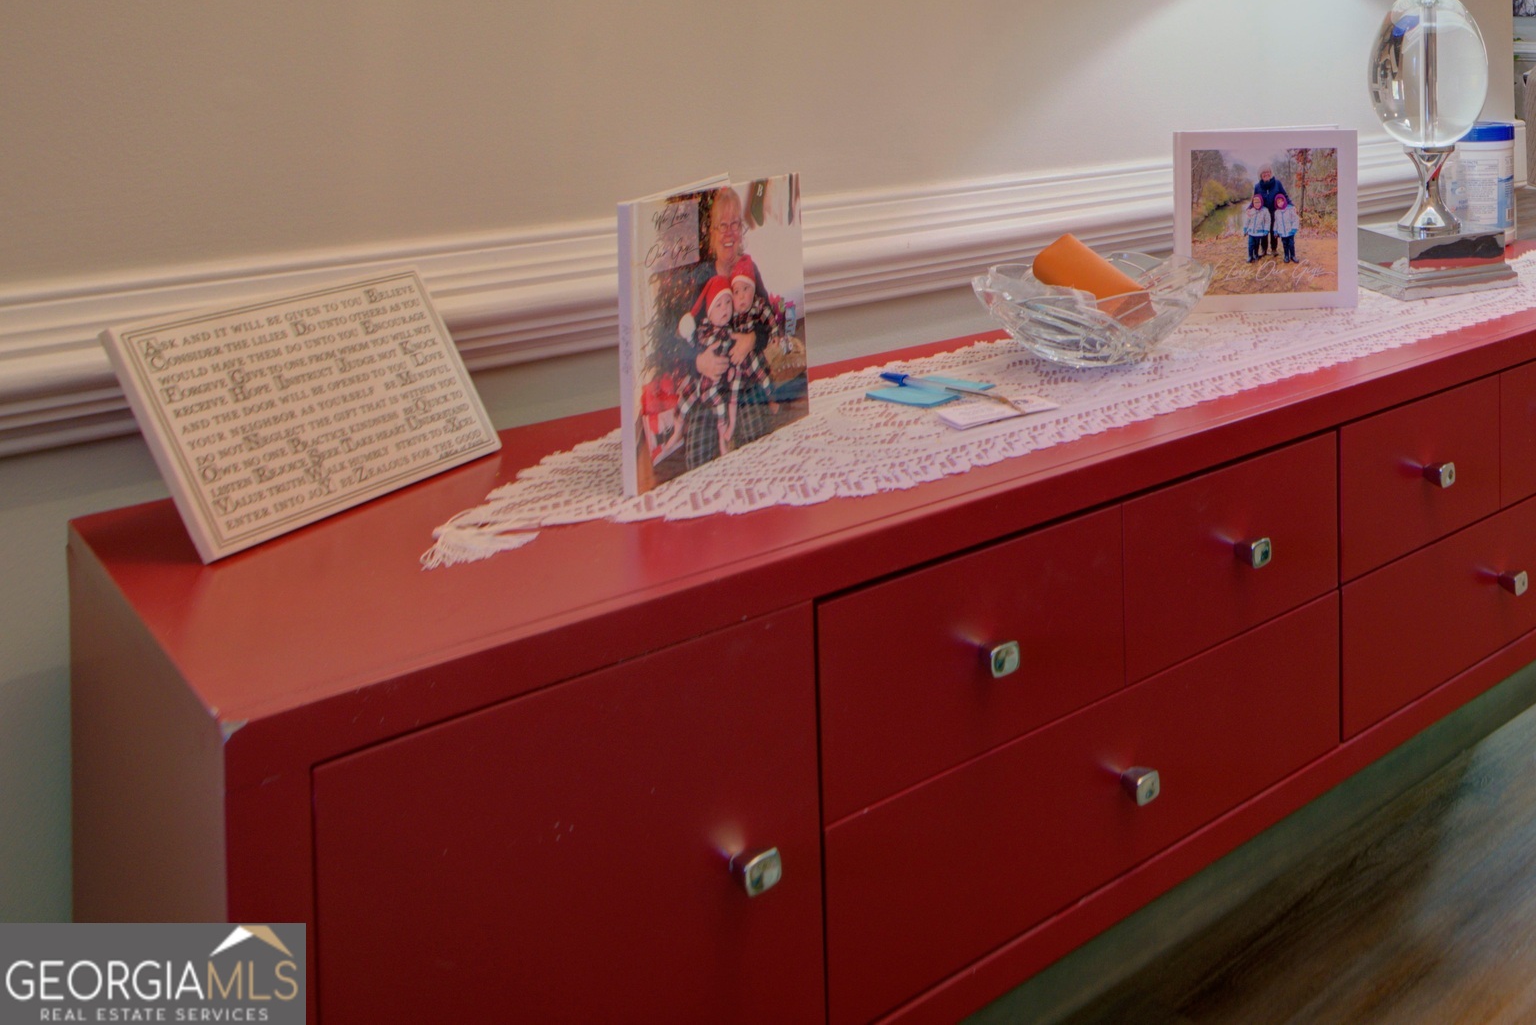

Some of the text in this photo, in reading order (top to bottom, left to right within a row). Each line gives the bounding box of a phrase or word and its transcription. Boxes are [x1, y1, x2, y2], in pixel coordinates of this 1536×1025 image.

[181, 332, 211, 345] AND
[214, 329, 227, 337] IT
[231, 320, 264, 333] WILL
[266, 316, 282, 325] BE
[285, 307, 321, 320] GIVEN
[323, 303, 338, 312] TO
[341, 298, 362, 307] YOU
[224, 340, 250, 352] THE
[251, 331, 288, 345] LILIES
[318, 317, 347, 329] UNTO
[348, 307, 387, 321] OTHERS
[402, 299, 420, 308] YOU
[267, 365, 283, 374] TO
[284, 359, 306, 370] ONE
[307, 351, 337, 363] FROM
[338, 342, 369, 355] WHOM
[371, 337, 390, 346] YOU
[391, 331, 413, 341] WILL
[414, 326, 431, 335] NOT
[157, 367, 208, 386] WOULD
[211, 358, 246, 372] HAVE
[247, 348, 282, 363] THEM
[285, 343, 303, 353] DO
[304, 335, 336, 348] UNTO
[337, 329, 359, 339] YOU
[173, 396, 228, 417] RECEIVE
[377, 350, 398, 360] NOT
[180, 419, 210, 433] AND
[212, 410, 240, 424] THE
[242, 400, 276, 415] DOOR
[279, 391, 309, 404] WILL
[311, 386, 325, 395] BE
[327, 373, 370, 390] OPENED
[372, 369, 385, 377] TO
[387, 362, 407, 373] YOU
[187, 432, 226, 450] YOUR
[229, 411, 296, 437] NEIGHBOR
[300, 405, 315, 415] AS
[317, 387, 375, 410] YOURSELF
[384, 381, 397, 389] BE
[195, 453, 215, 465] DO
[217, 444, 244, 458] NOT
[308, 417, 331, 429] THE
[333, 409, 358, 421] GIFT
[360, 400, 387, 413] THAT
[389, 396, 399, 404] IS
[400, 384, 437, 400] WITHIN
[438, 378, 456, 388] YOU
[242, 457, 260, 468] NO
[262, 448, 288, 461] ONE
[403, 407, 414, 415] BE
[451, 391, 463, 399] TO
[211, 478, 252, 497] LISTEN
[306, 446, 341, 465] SEEK
[376, 425, 407, 440] HEART
[225, 507, 270, 530] ENTER
[273, 495, 305, 512] INTO
[340, 477, 354, 487] BE
[411, 448, 432, 461] FOR
[432, 441, 453, 453] THE
[455, 430, 482, 445] GOOD
[266, 477, 306, 496] TRUTH
[348, 447, 390, 467] HUMBLY
[429, 429, 442, 438] TO
